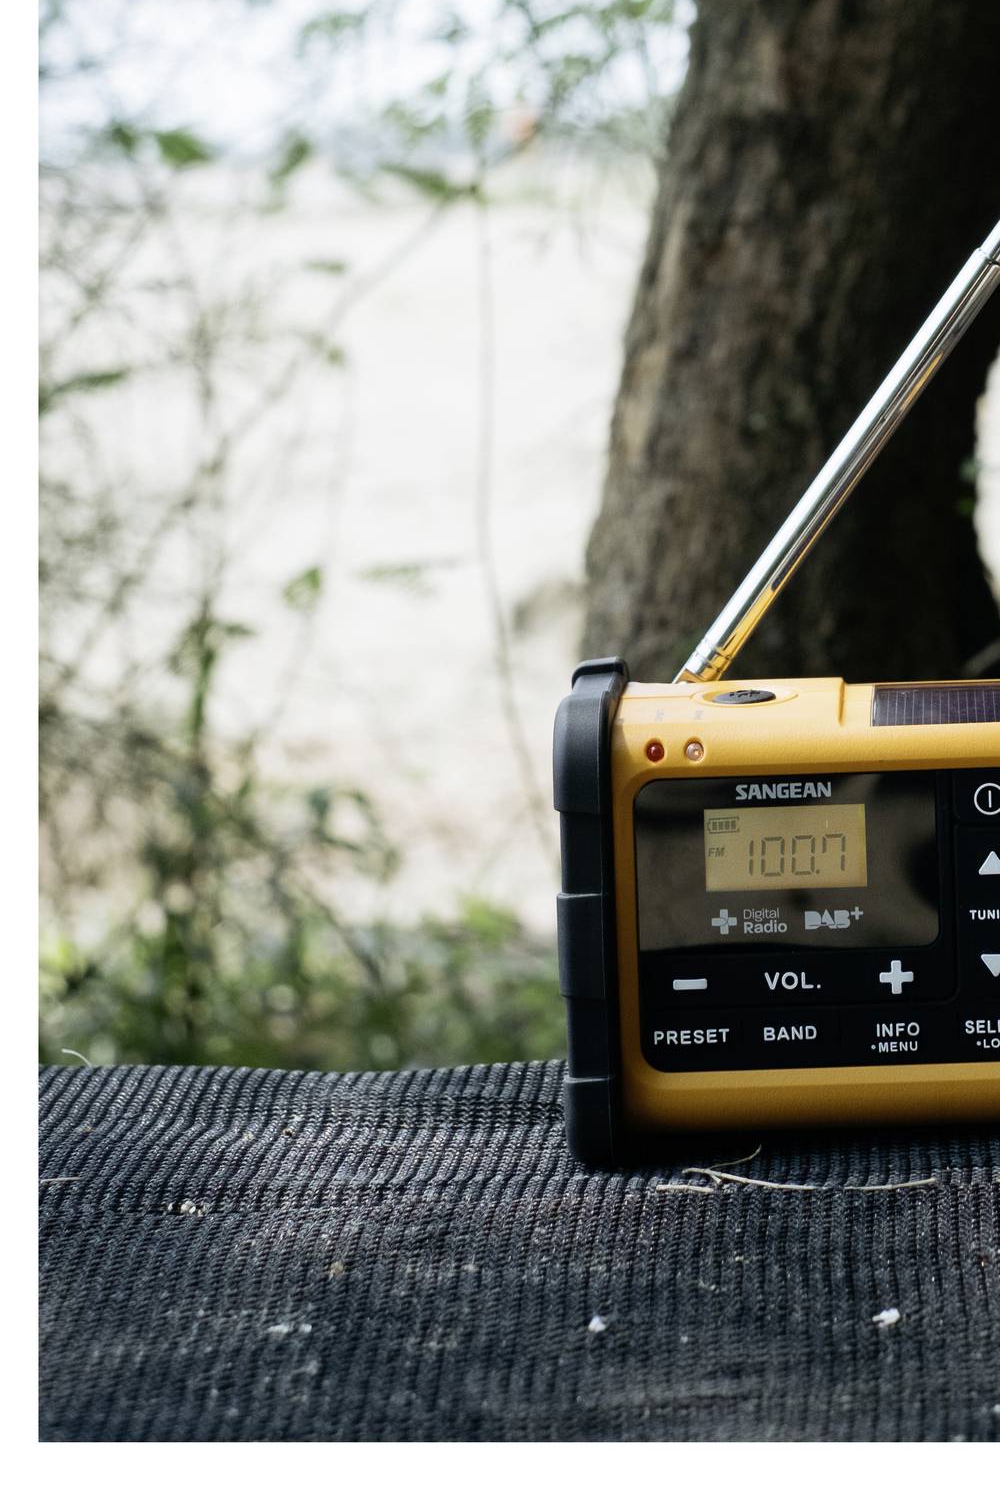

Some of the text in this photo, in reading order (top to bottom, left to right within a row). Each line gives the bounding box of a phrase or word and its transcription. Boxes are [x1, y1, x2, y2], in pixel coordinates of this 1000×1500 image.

[735, 781, 832, 800] SANGEAN
[708, 847, 725, 858] FM
[749, 833, 846, 877] 100.7
[743, 908, 780, 922] Digital
[743, 920, 788, 934] Radio
[764, 971, 822, 990] VOL.
[653, 1028, 730, 1046] PRESET
[763, 1025, 818, 1042] BAND
[876, 1022, 920, 1038] INFO
